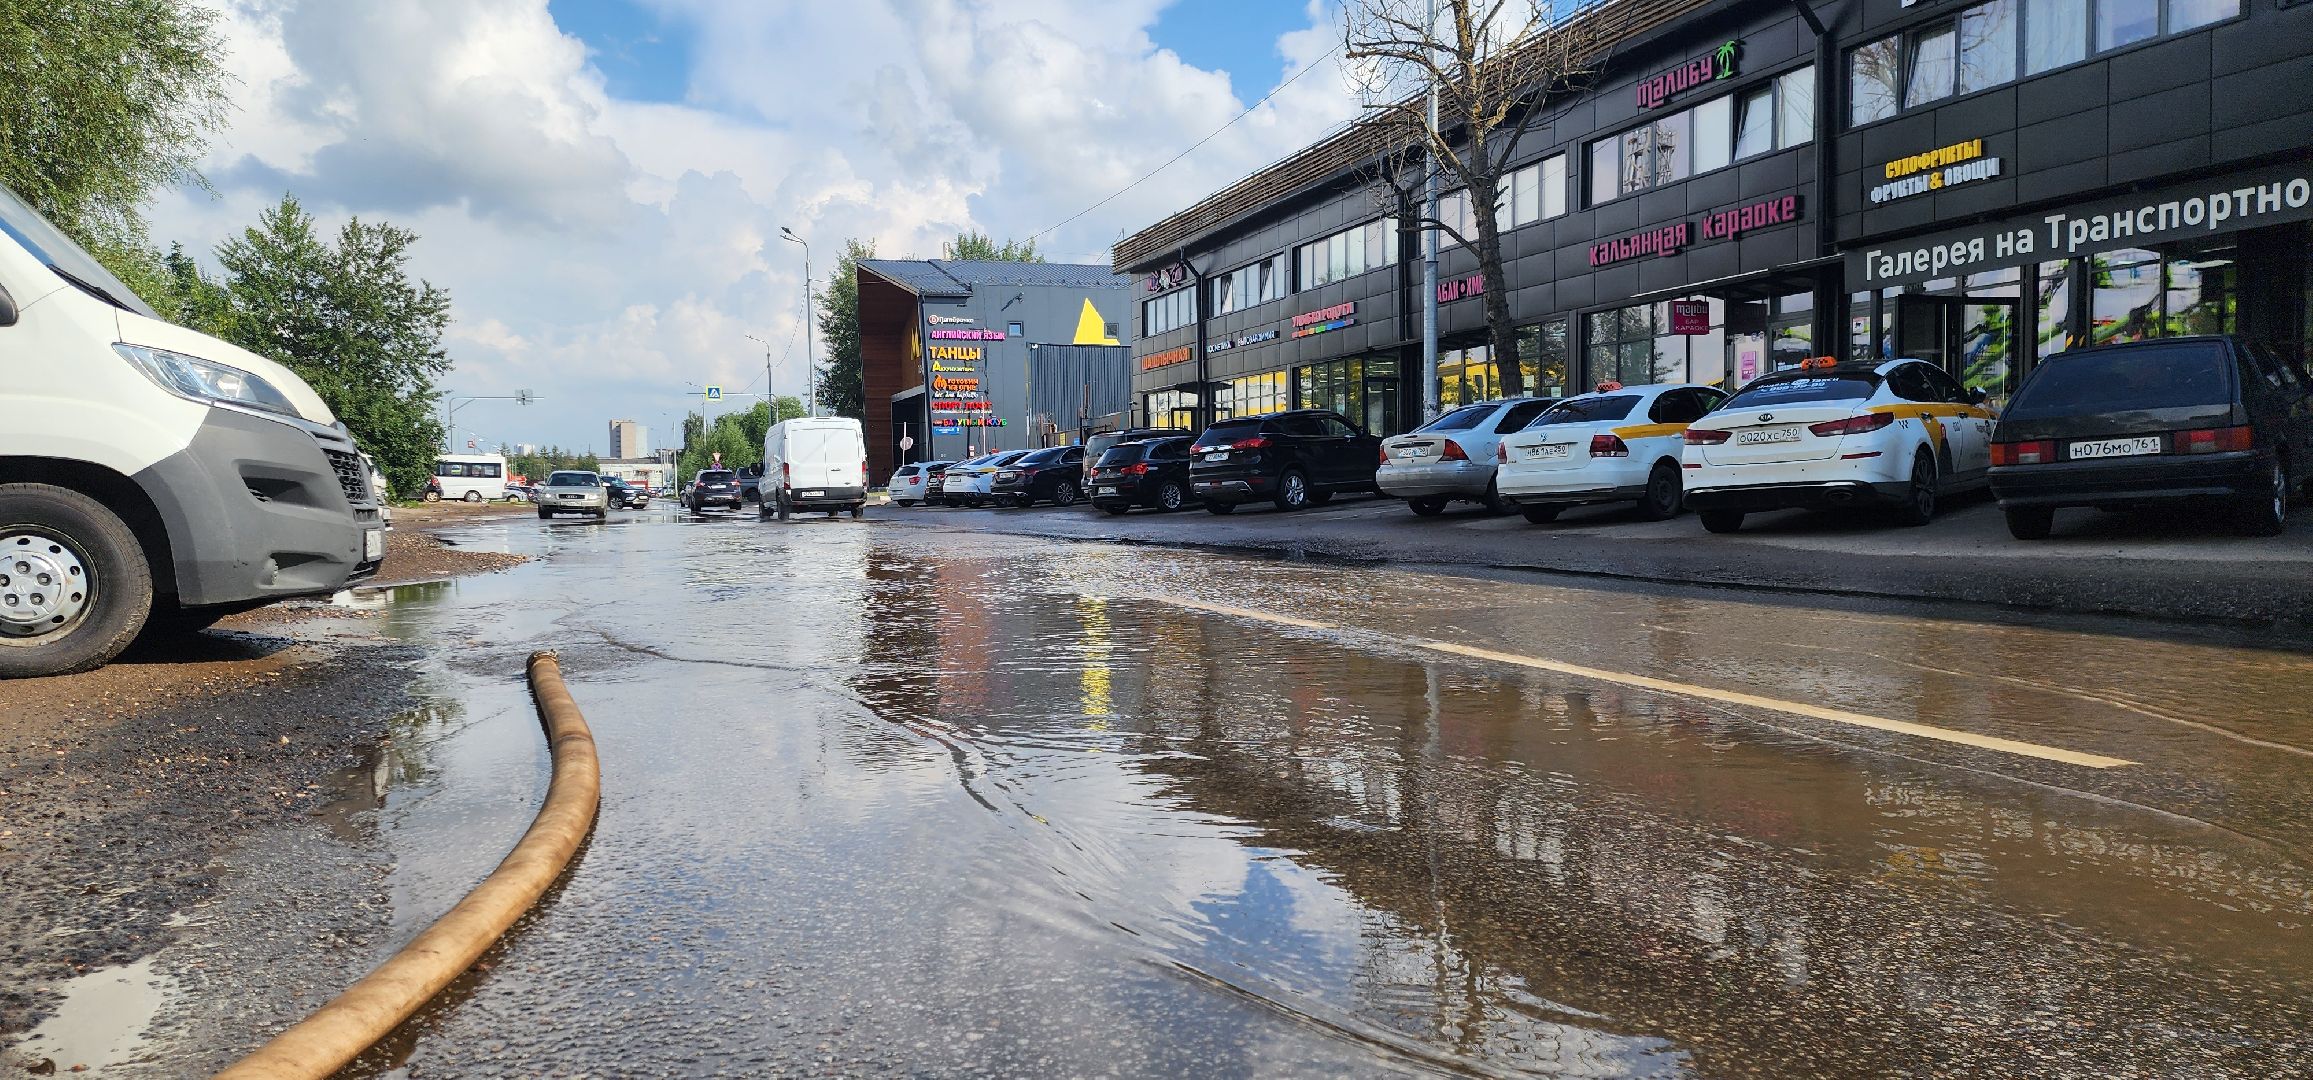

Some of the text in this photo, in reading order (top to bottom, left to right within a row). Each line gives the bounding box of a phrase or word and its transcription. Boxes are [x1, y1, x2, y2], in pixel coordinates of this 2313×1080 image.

[1886, 139, 1982, 178] СУХОФРУКТЫ
[1871, 157, 2000, 203] ФРУКТЫ & ОВОЩИ
[1702, 195, 1796, 240] караоке
[1866, 178, 2312, 281] Галерея на Транспортно
[1437, 279, 1459, 303] АБАК
[932, 329, 981, 340] АНГЛИЙСКИЙ
[930, 346, 981, 360] ТАНЦЫ
[1143, 347, 1190, 369] ШАШЛЫЧНАЯ
[1782, 429, 1798, 437] 750
[2074, 439, 2156, 457] Н076МО 761
